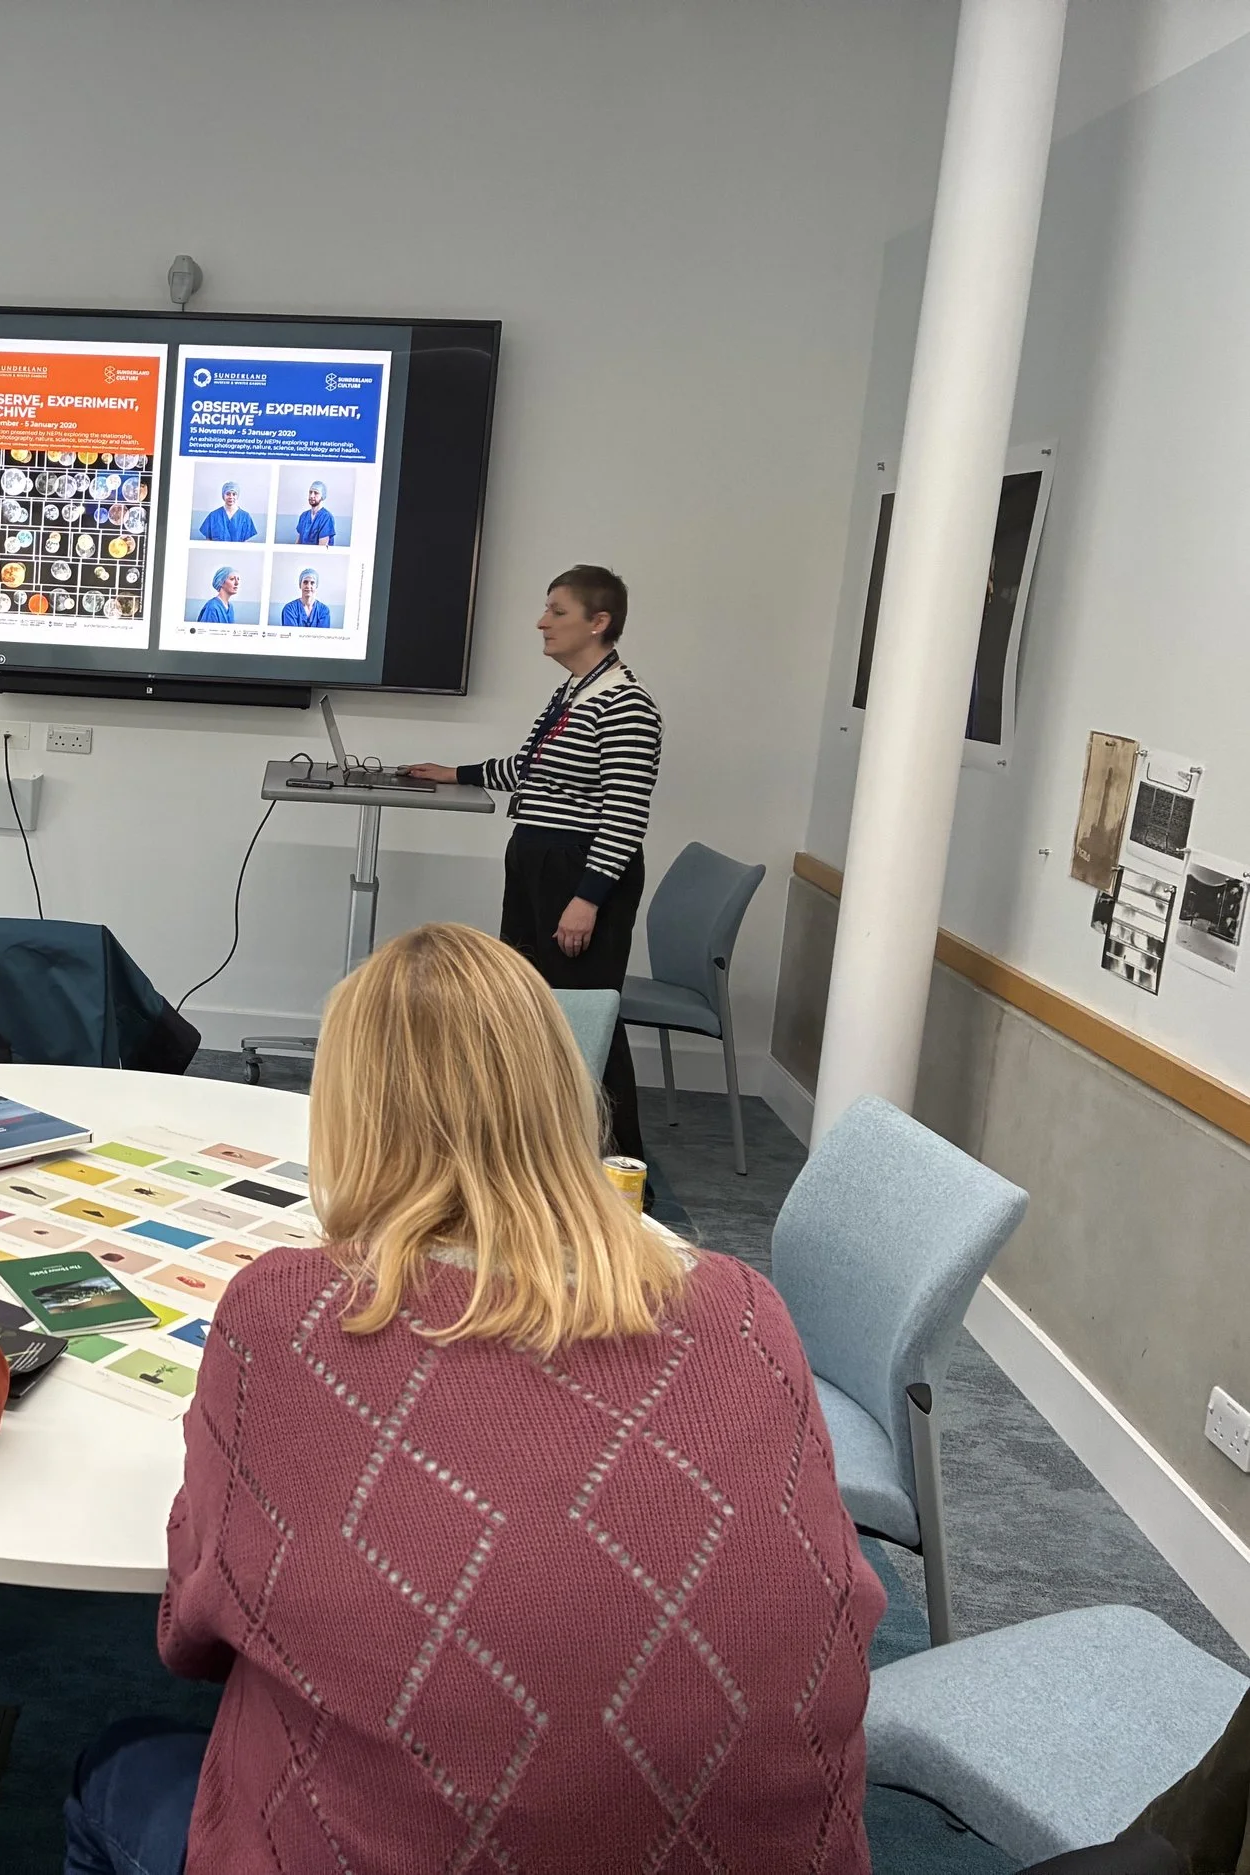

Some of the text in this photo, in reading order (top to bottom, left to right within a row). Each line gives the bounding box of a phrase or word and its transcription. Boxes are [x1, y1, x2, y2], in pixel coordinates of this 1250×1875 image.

[213, 372, 268, 380] SUNDERLAND
[47, 395, 140, 412] EXPERIMENT,
[191, 400, 361, 420] OBSERVE, EXPERIMENT,
[190, 412, 255, 426] ARCHIVE
[30, 421, 59, 429] January
[59, 421, 78, 429] 2020
[63, 431, 90, 439] exploring
[100, 432, 133, 440] relationship
[190, 426, 198, 434] 15
[198, 427, 237, 435] November
[247, 428, 277, 437] January
[281, 439, 309, 447] exploring
